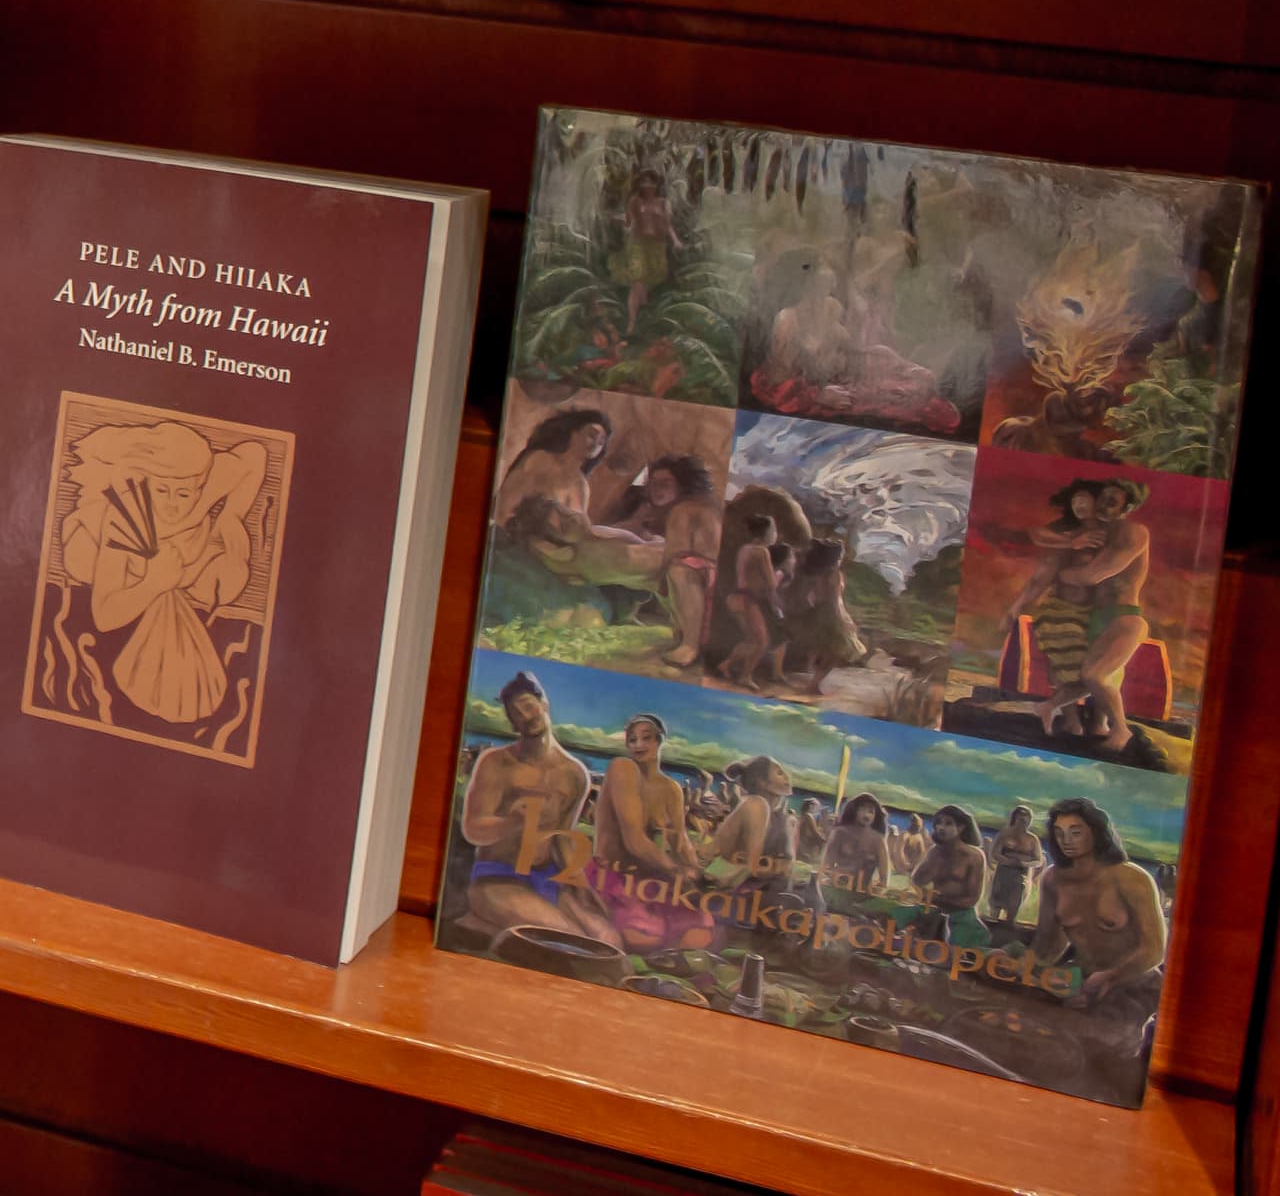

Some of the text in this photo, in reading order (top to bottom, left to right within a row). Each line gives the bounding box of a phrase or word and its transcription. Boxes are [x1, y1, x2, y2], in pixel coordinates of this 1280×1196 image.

[80, 241, 313, 299] PELE AND HIIAKA
[54, 278, 331, 348] A Myth from Hawaii
[79, 327, 293, 385] Nathaniel B. Emerson
